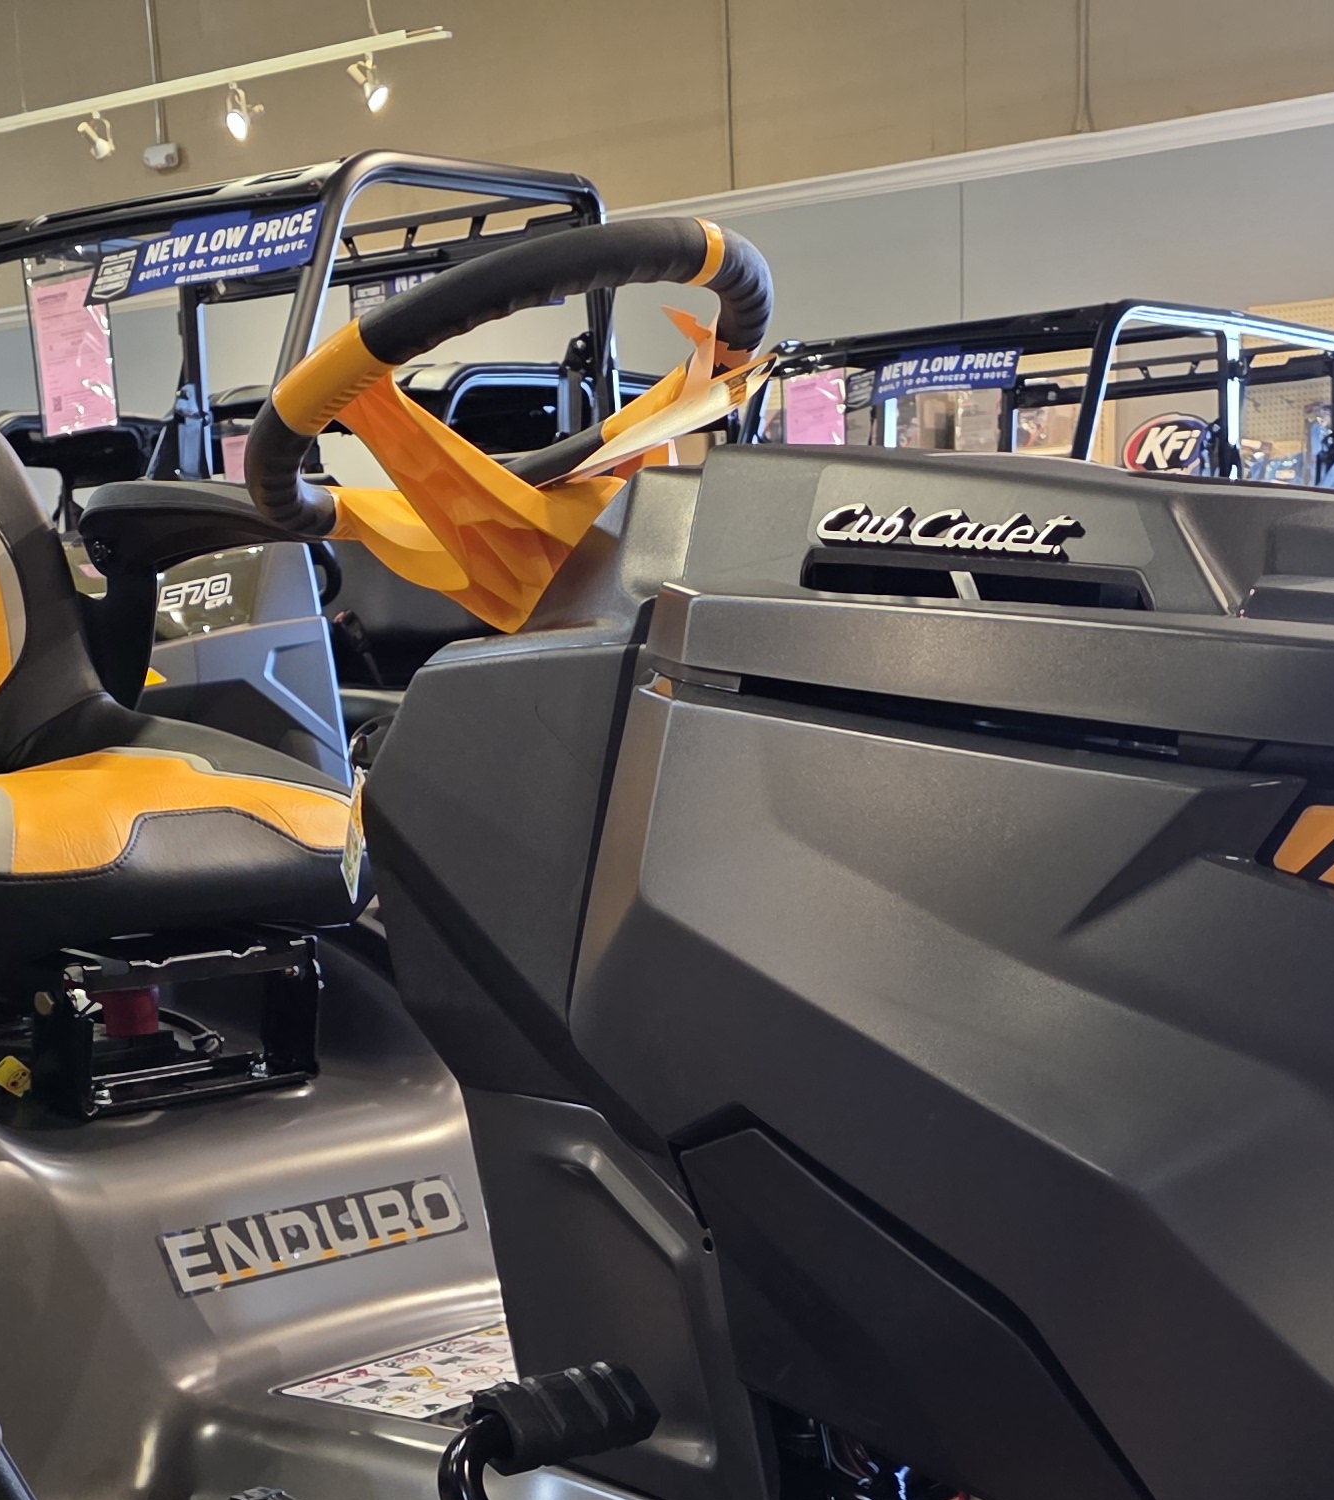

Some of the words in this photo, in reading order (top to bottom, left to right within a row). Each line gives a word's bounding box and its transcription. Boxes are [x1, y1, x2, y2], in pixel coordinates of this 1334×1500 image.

[143, 234, 194, 267] NEW
[195, 225, 248, 255] LOW
[250, 208, 317, 245] PRICE
[138, 265, 169, 282] BUILT
[172, 262, 186, 273] TO
[211, 251, 254, 267] PRICED
[257, 246, 271, 258] TO
[881, 361, 918, 382] NEW
[920, 355, 960, 374] LOW
[962, 351, 1017, 370] PRICE
[816, 502, 913, 544] Cub
[157, 573, 231, 612] 570
[164, 1179, 463, 1293] ENDURO
